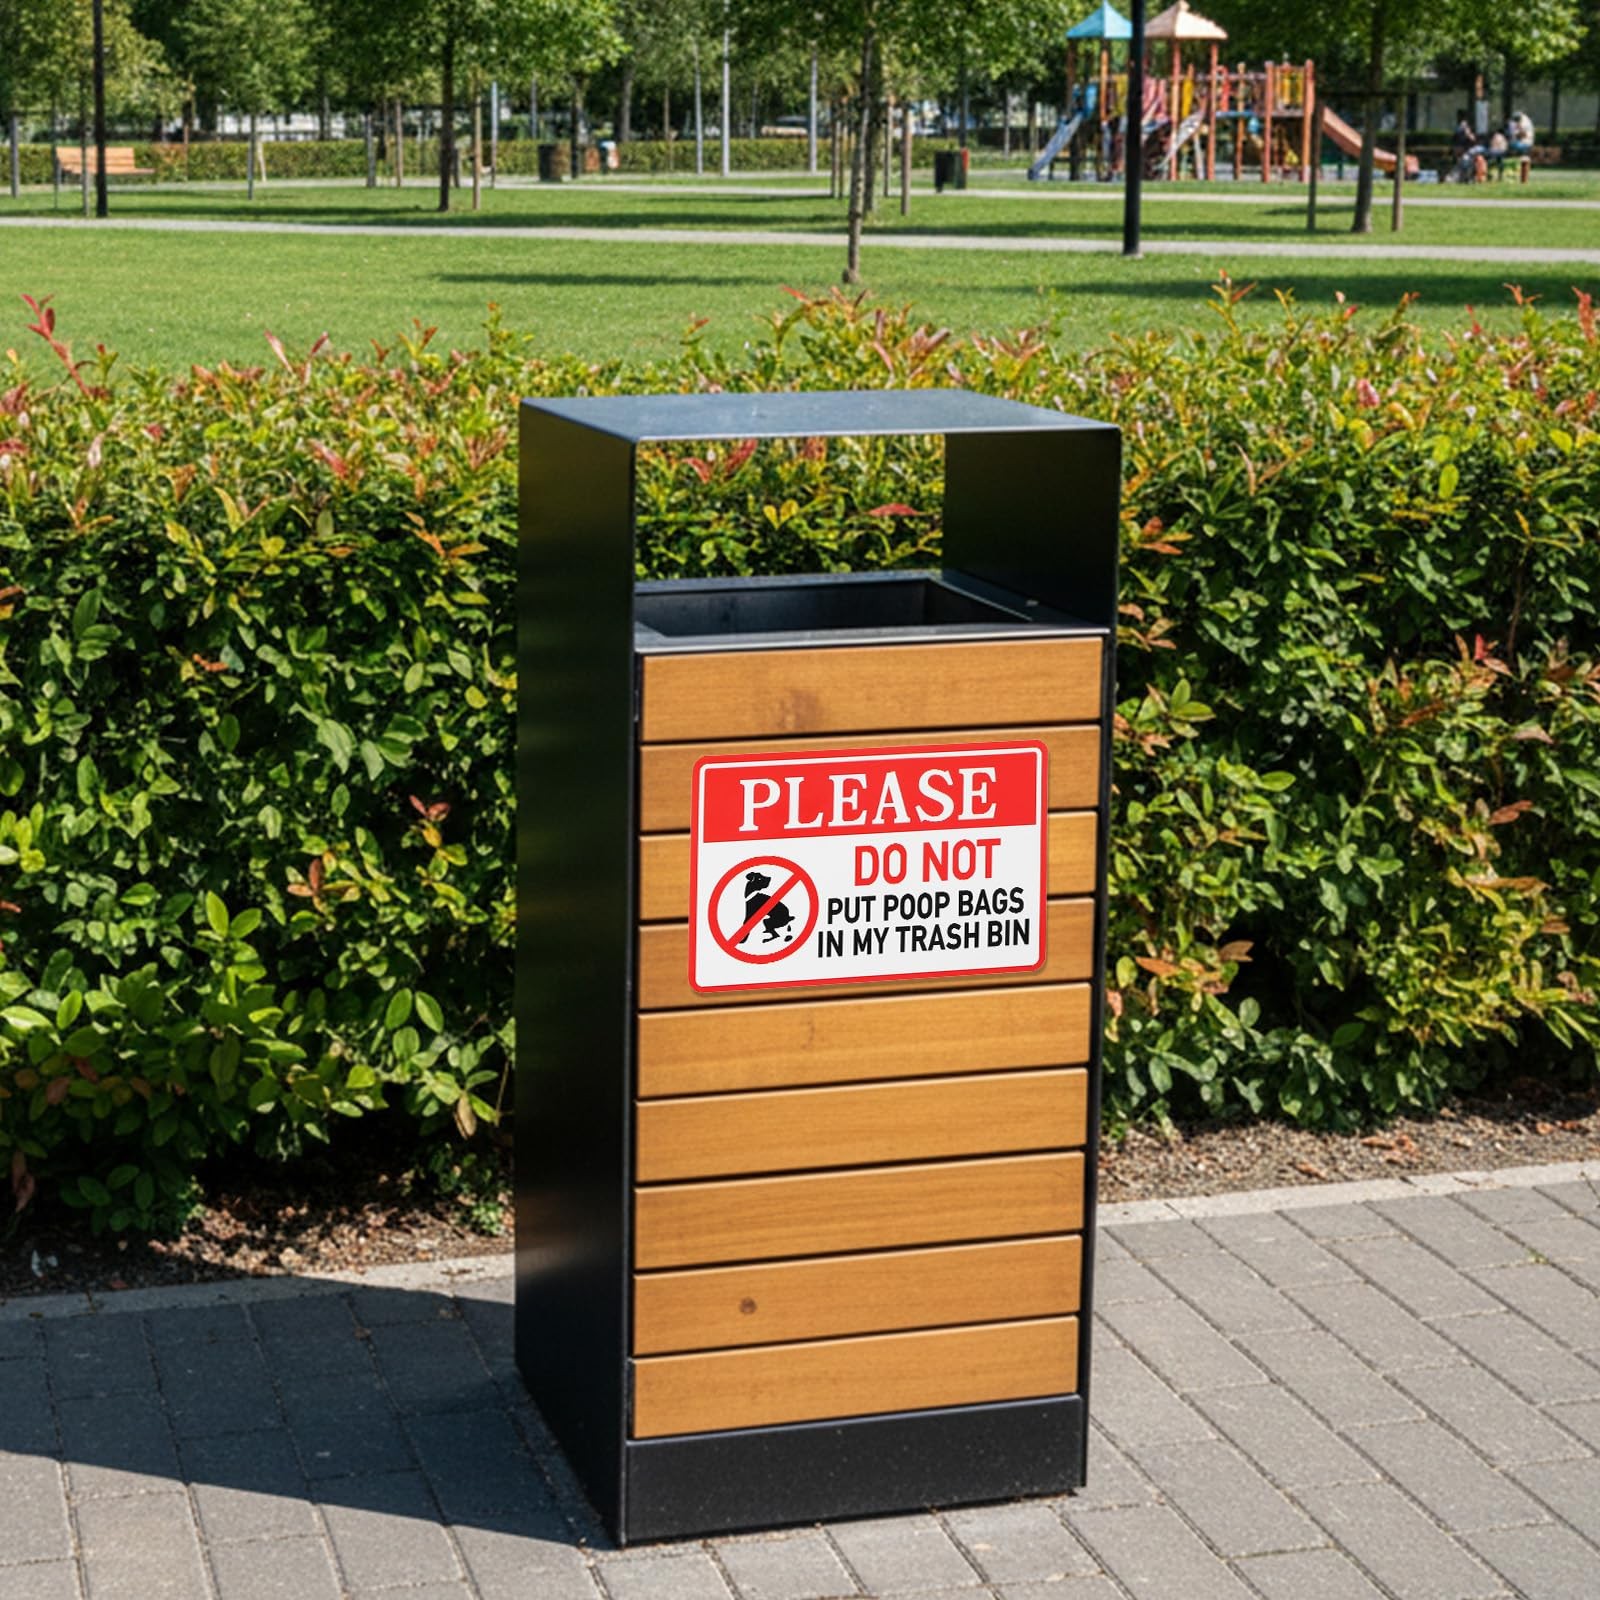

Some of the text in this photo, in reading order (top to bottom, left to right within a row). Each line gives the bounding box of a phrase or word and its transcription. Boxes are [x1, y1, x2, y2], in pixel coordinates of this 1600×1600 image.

[738, 767, 997, 832] PLEASE
[854, 838, 1001, 886] DO NOT
[827, 887, 1025, 924] PUT POOP BAGS
[817, 918, 1030, 958] IN MY TRASH BIN
